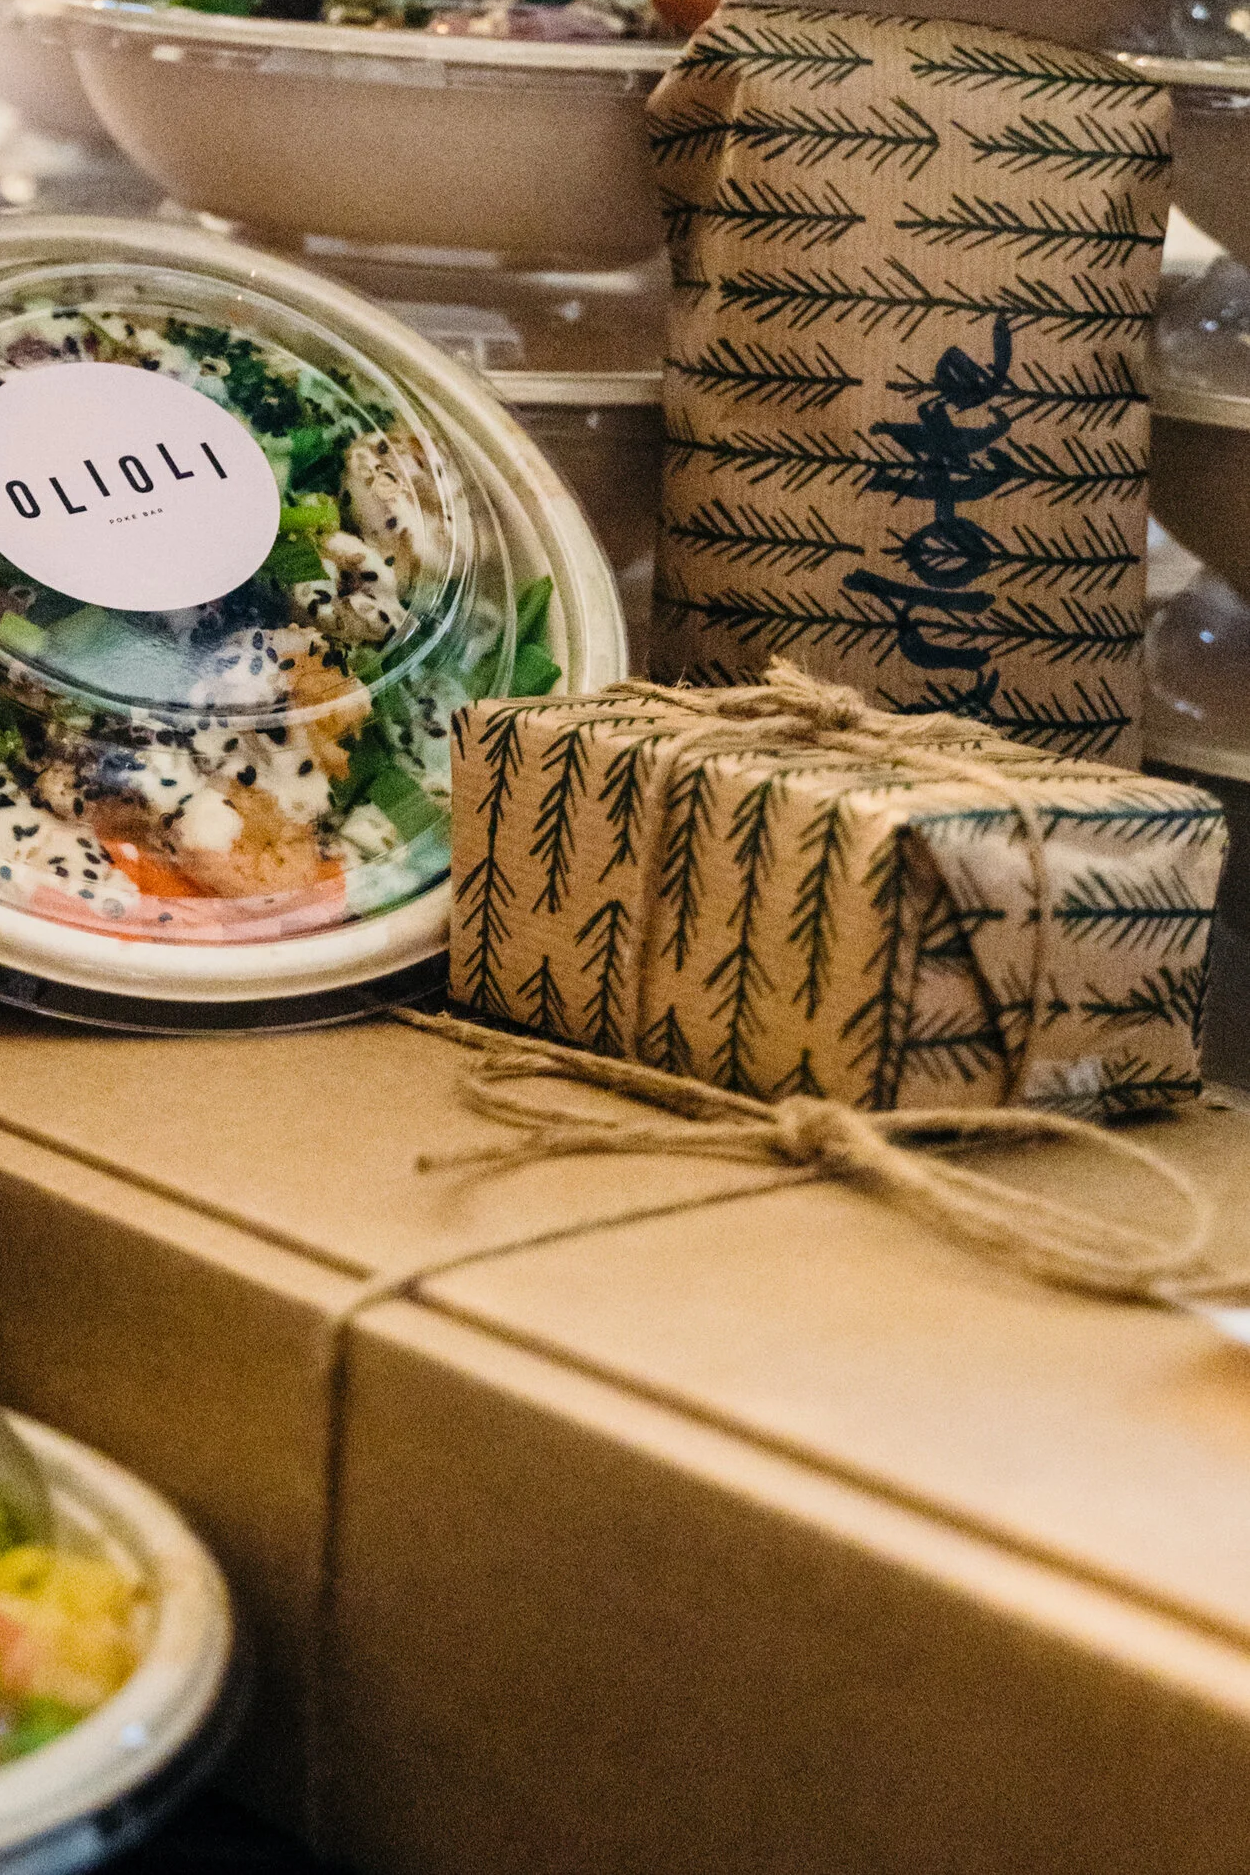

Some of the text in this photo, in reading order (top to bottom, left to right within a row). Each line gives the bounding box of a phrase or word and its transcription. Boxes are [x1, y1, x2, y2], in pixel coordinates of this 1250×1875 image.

[5, 442, 228, 519] OLIOLI
[109, 507, 164, 525] POKE BAR
